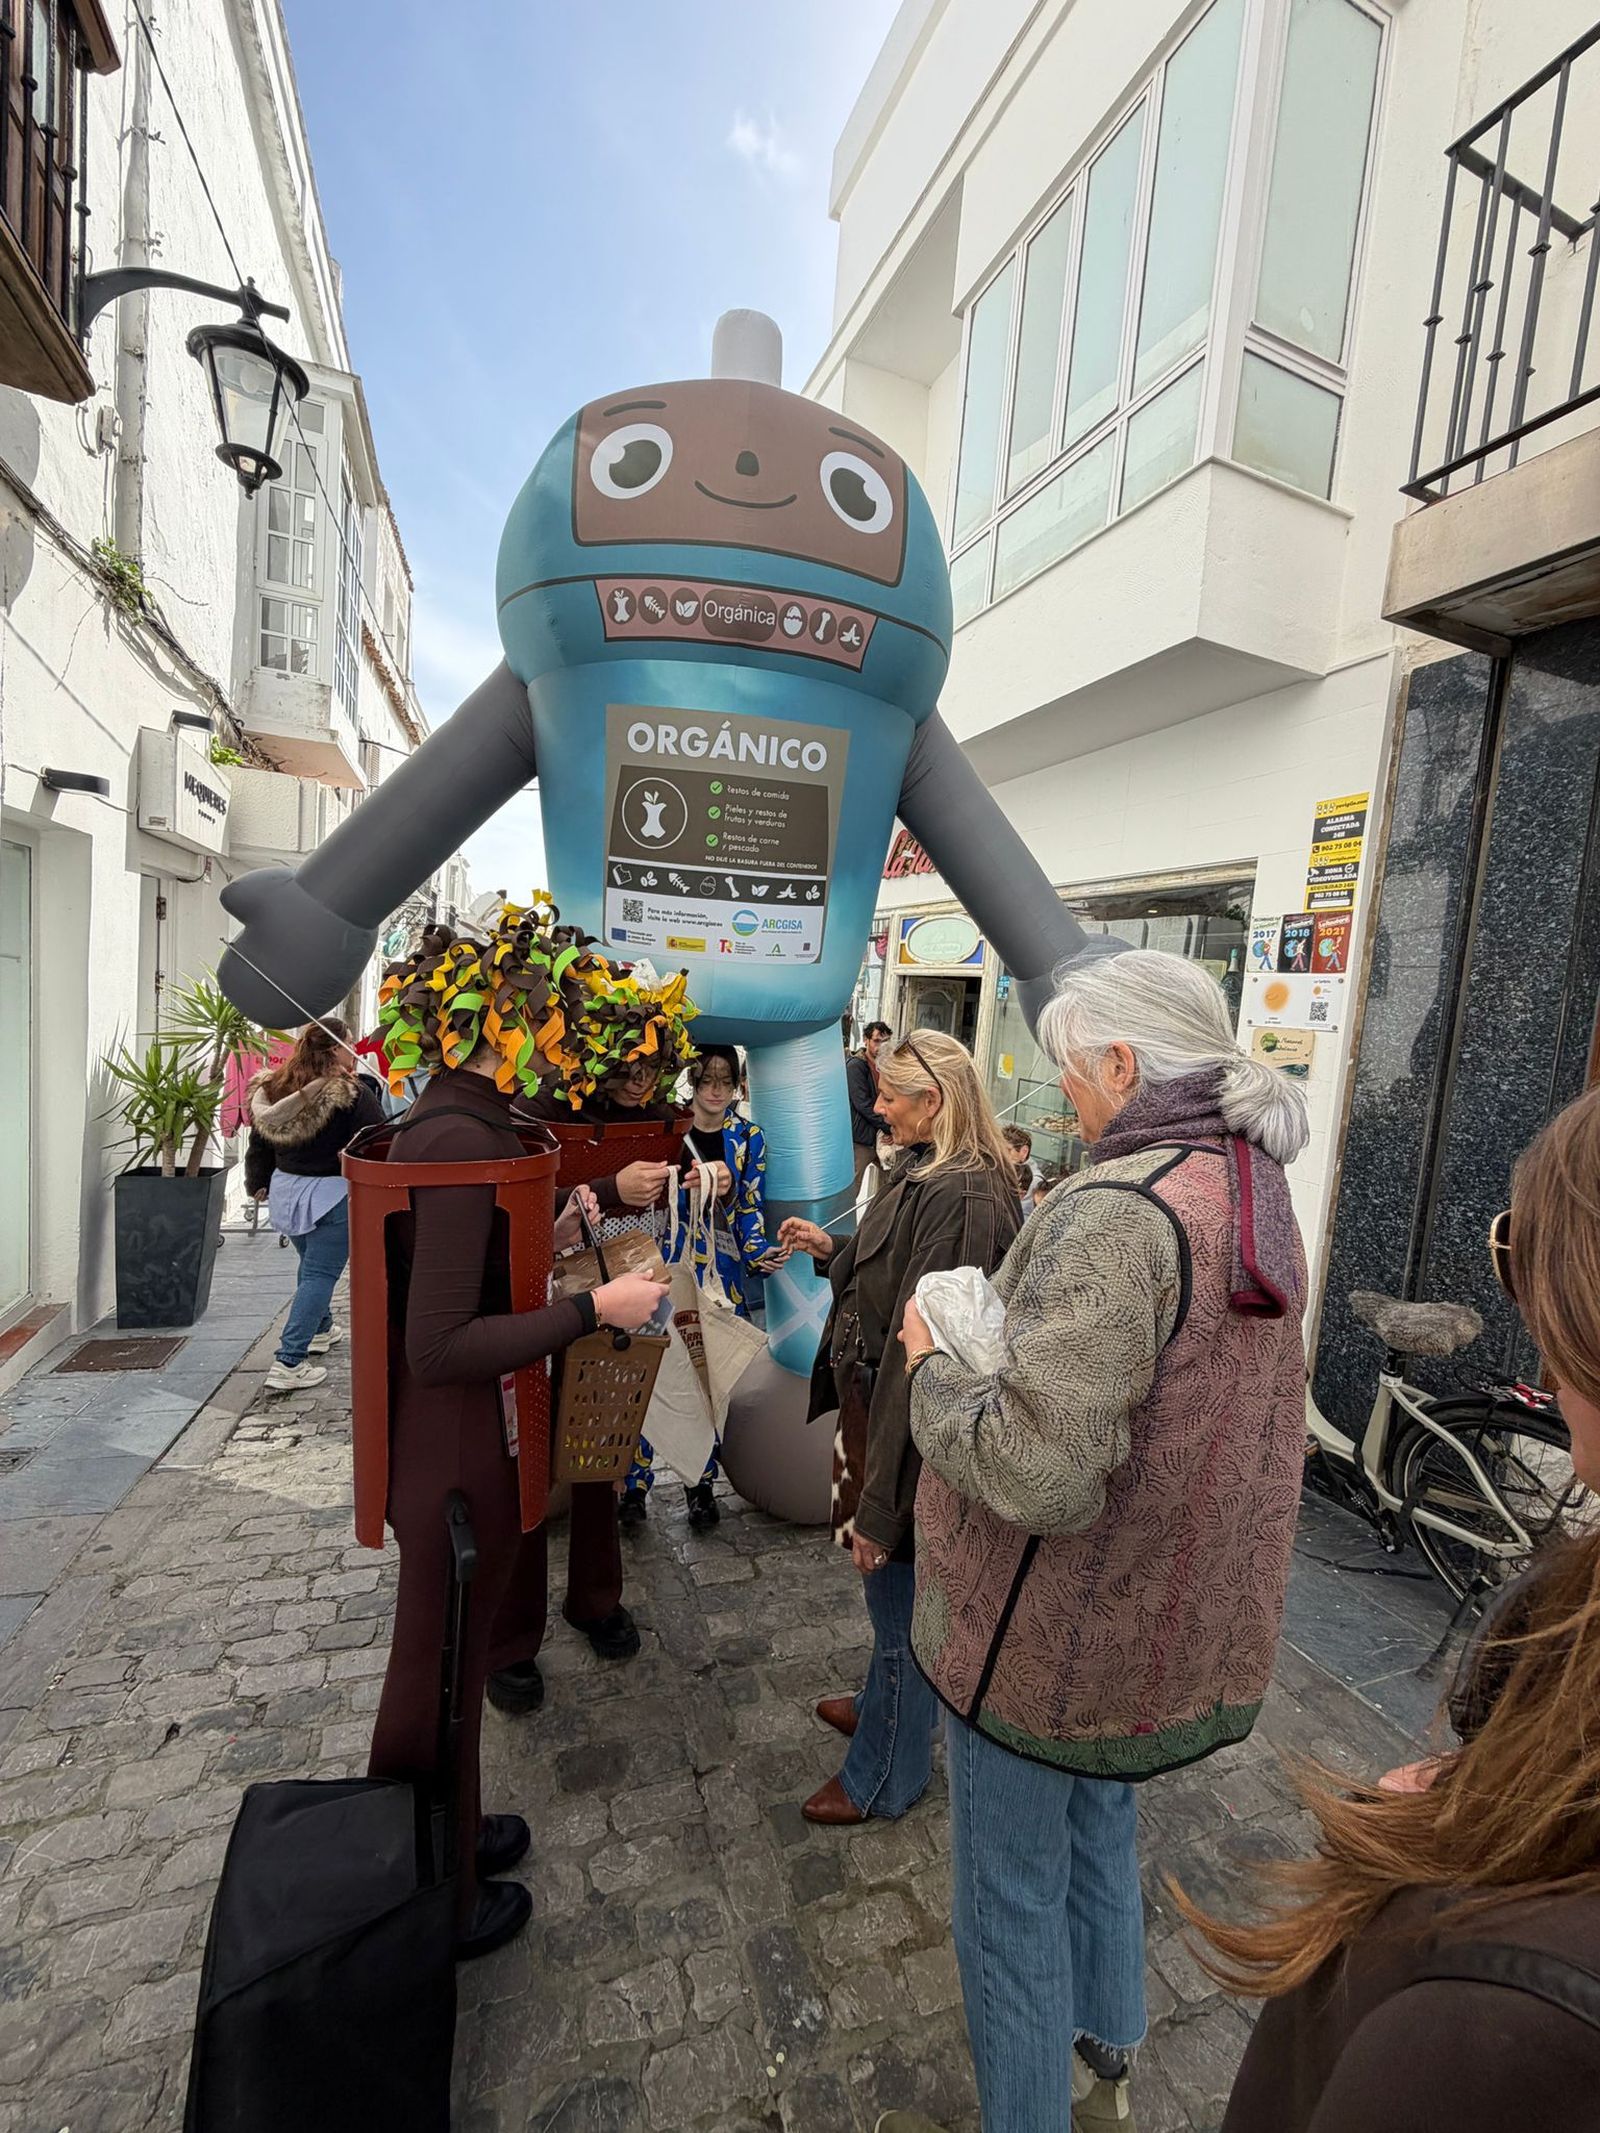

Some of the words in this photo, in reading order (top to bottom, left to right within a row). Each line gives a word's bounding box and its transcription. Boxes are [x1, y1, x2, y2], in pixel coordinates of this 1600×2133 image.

[703, 599, 776, 626] Orgánica
[627, 720, 828, 772] ORGÁNICO
[751, 787, 762, 797] de
[763, 791, 790, 801] comida
[725, 803, 746, 814] Pieles
[755, 809, 777, 818] restos
[778, 809, 788, 819] de
[724, 812, 746, 824] frutas
[747, 818, 754, 826] y
[754, 818, 786, 828] verduras
[1326, 814, 1355, 825] ALARMA
[1320, 821, 1361, 834] CONECTADA
[722, 831, 746, 842] Restos
[747, 834, 758, 844] de
[759, 837, 780, 846] carne
[721, 843, 727, 851] y
[728, 843, 760, 853] pescado
[1321, 844, 1333, 852] 902
[1334, 842, 1342, 850] 75
[705, 854, 715, 862] NO
[737, 858, 759, 866] BASURA
[786, 862, 818, 870] CONTENEDOR
[1324, 866, 1343, 875] ZONA
[1309, 872, 1358, 884] VIDEOVIGILADA
[1310, 883, 1343, 891] SEGURIDAD
[761, 918, 803, 930] ARCGISA
[1252, 929, 1277, 939] 2017
[1284, 927, 1311, 938] 2018
[1319, 926, 1345, 937] 2021
